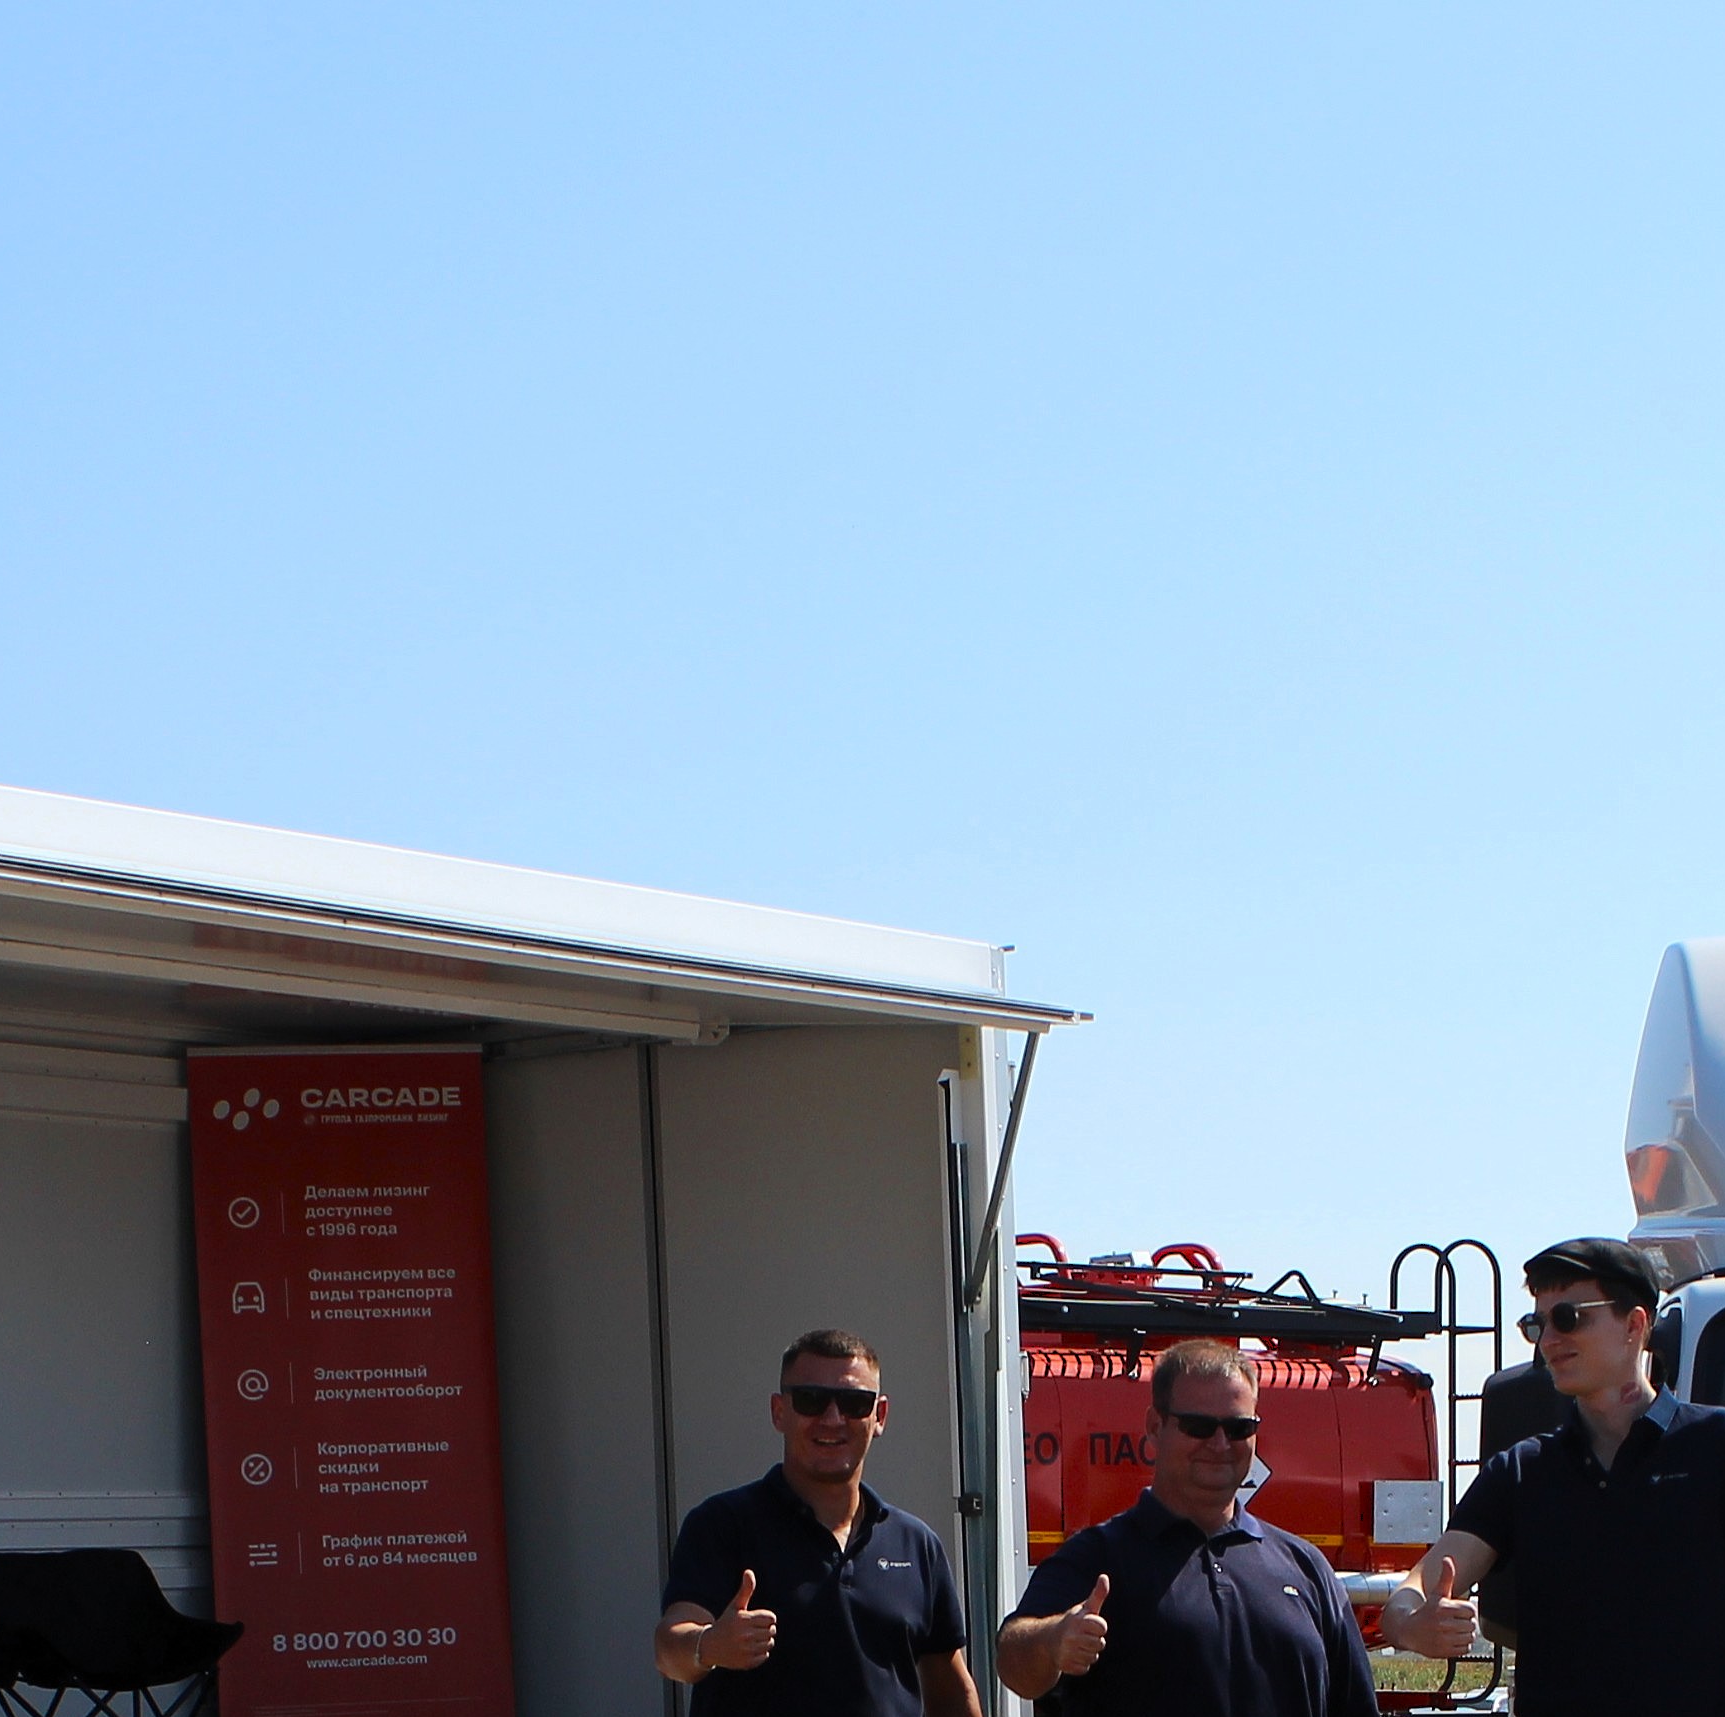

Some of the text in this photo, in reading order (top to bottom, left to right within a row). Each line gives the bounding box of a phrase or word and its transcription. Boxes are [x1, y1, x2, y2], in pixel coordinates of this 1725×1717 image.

[300, 1086, 462, 1109] CARCADE
[320, 1112, 449, 1124] ГРУППА ГАЗПРОМБАНК ЛИЗИНГ
[304, 1185, 430, 1201] Делаем лизинг
[305, 1205, 393, 1220] доступнее
[306, 1223, 398, 1237] с 1996 года
[308, 1268, 456, 1284] Финансируем все
[310, 1286, 453, 1303] виды транспорта
[310, 1306, 432, 1321] и спецтехники
[314, 1365, 428, 1382] Электронный
[315, 1384, 463, 1401] документооборот
[317, 1440, 449, 1458] Корпоративные
[318, 1461, 380, 1476] скидки
[319, 1479, 429, 1495] на транспорт
[322, 1530, 468, 1550] График платежей
[323, 1550, 478, 1569] от 6 до 84 месяцев
[273, 1627, 457, 1652] 8 800 700 30 30
[306, 1653, 428, 1669] www.carcade.com
